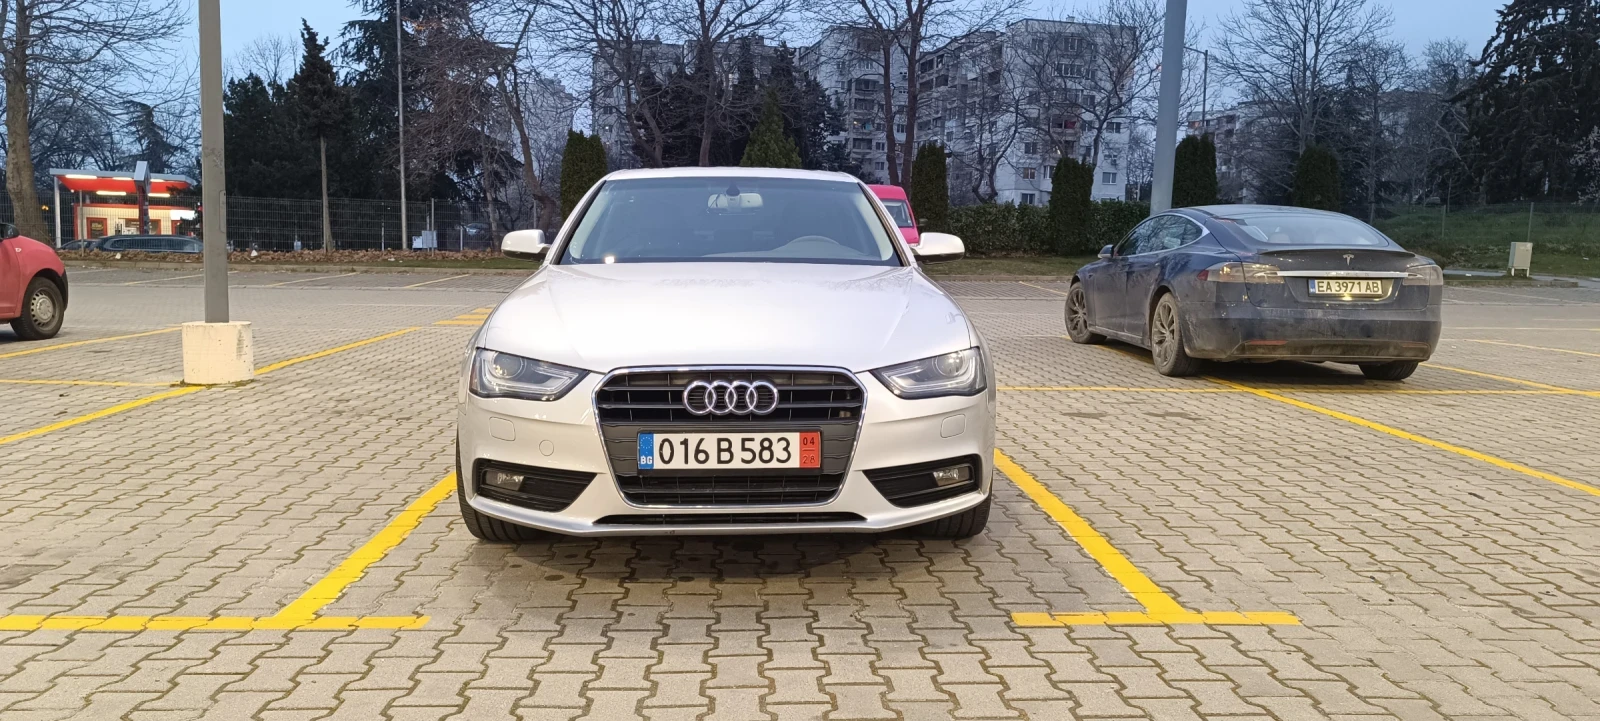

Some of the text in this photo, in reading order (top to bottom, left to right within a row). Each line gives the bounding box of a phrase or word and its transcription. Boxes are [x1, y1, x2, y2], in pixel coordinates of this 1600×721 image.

[1317, 281, 1332, 293] EA
[1335, 281, 1361, 293] 3971
[1365, 281, 1380, 293] AB
[802, 437, 815, 446] 04
[658, 437, 710, 465] 016
[740, 436, 792, 464] 583
[640, 455, 653, 464] BG
[802, 454, 815, 464] 28
